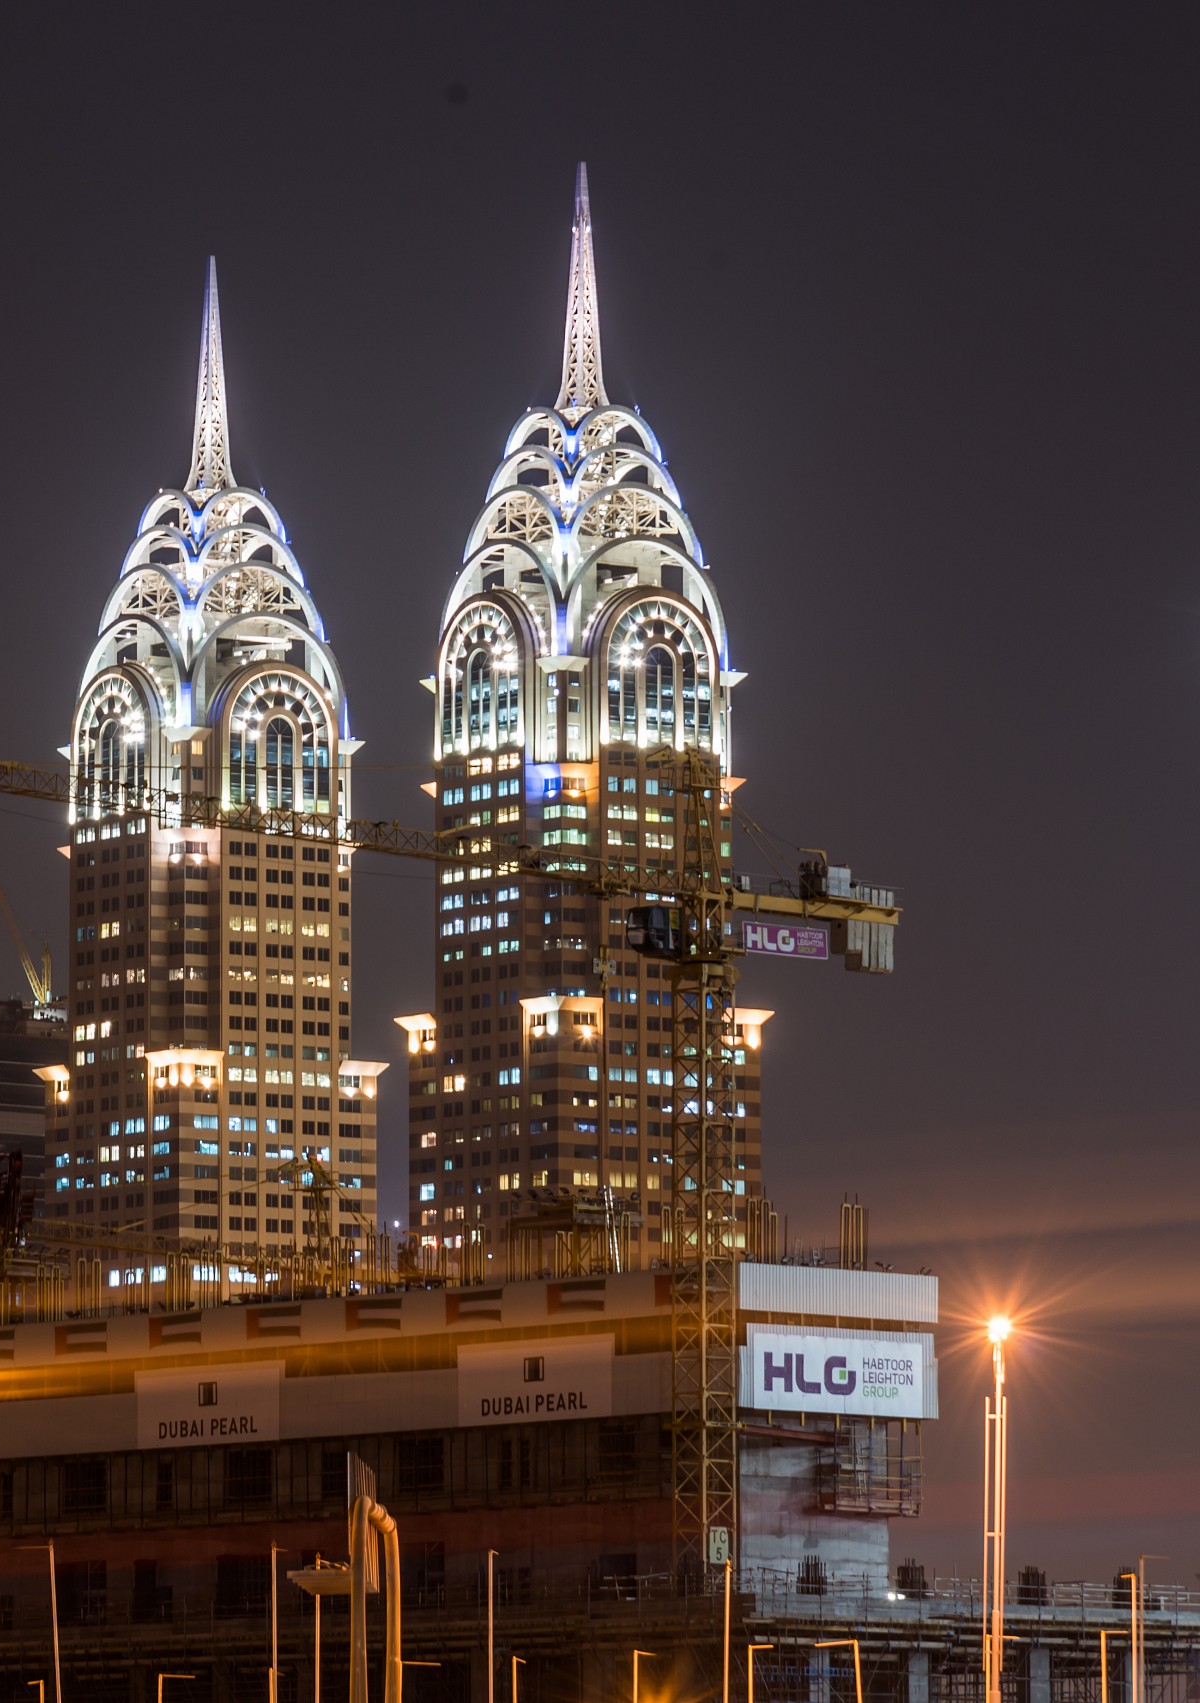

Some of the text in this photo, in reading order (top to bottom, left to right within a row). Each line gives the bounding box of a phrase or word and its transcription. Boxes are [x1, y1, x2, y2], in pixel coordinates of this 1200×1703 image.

[746, 925, 795, 952] HLG
[862, 1357, 913, 1372] HABTOOR
[764, 1351, 857, 1396] HLG
[862, 1371, 914, 1386] LEIGHTON
[862, 1385, 899, 1399] GROUP
[481, 1391, 588, 1417] DUBAI PEARL
[159, 1415, 258, 1439] DUBAI PEARL
[712, 1529, 727, 1544] TC
[716, 1546, 722, 1561] 5
